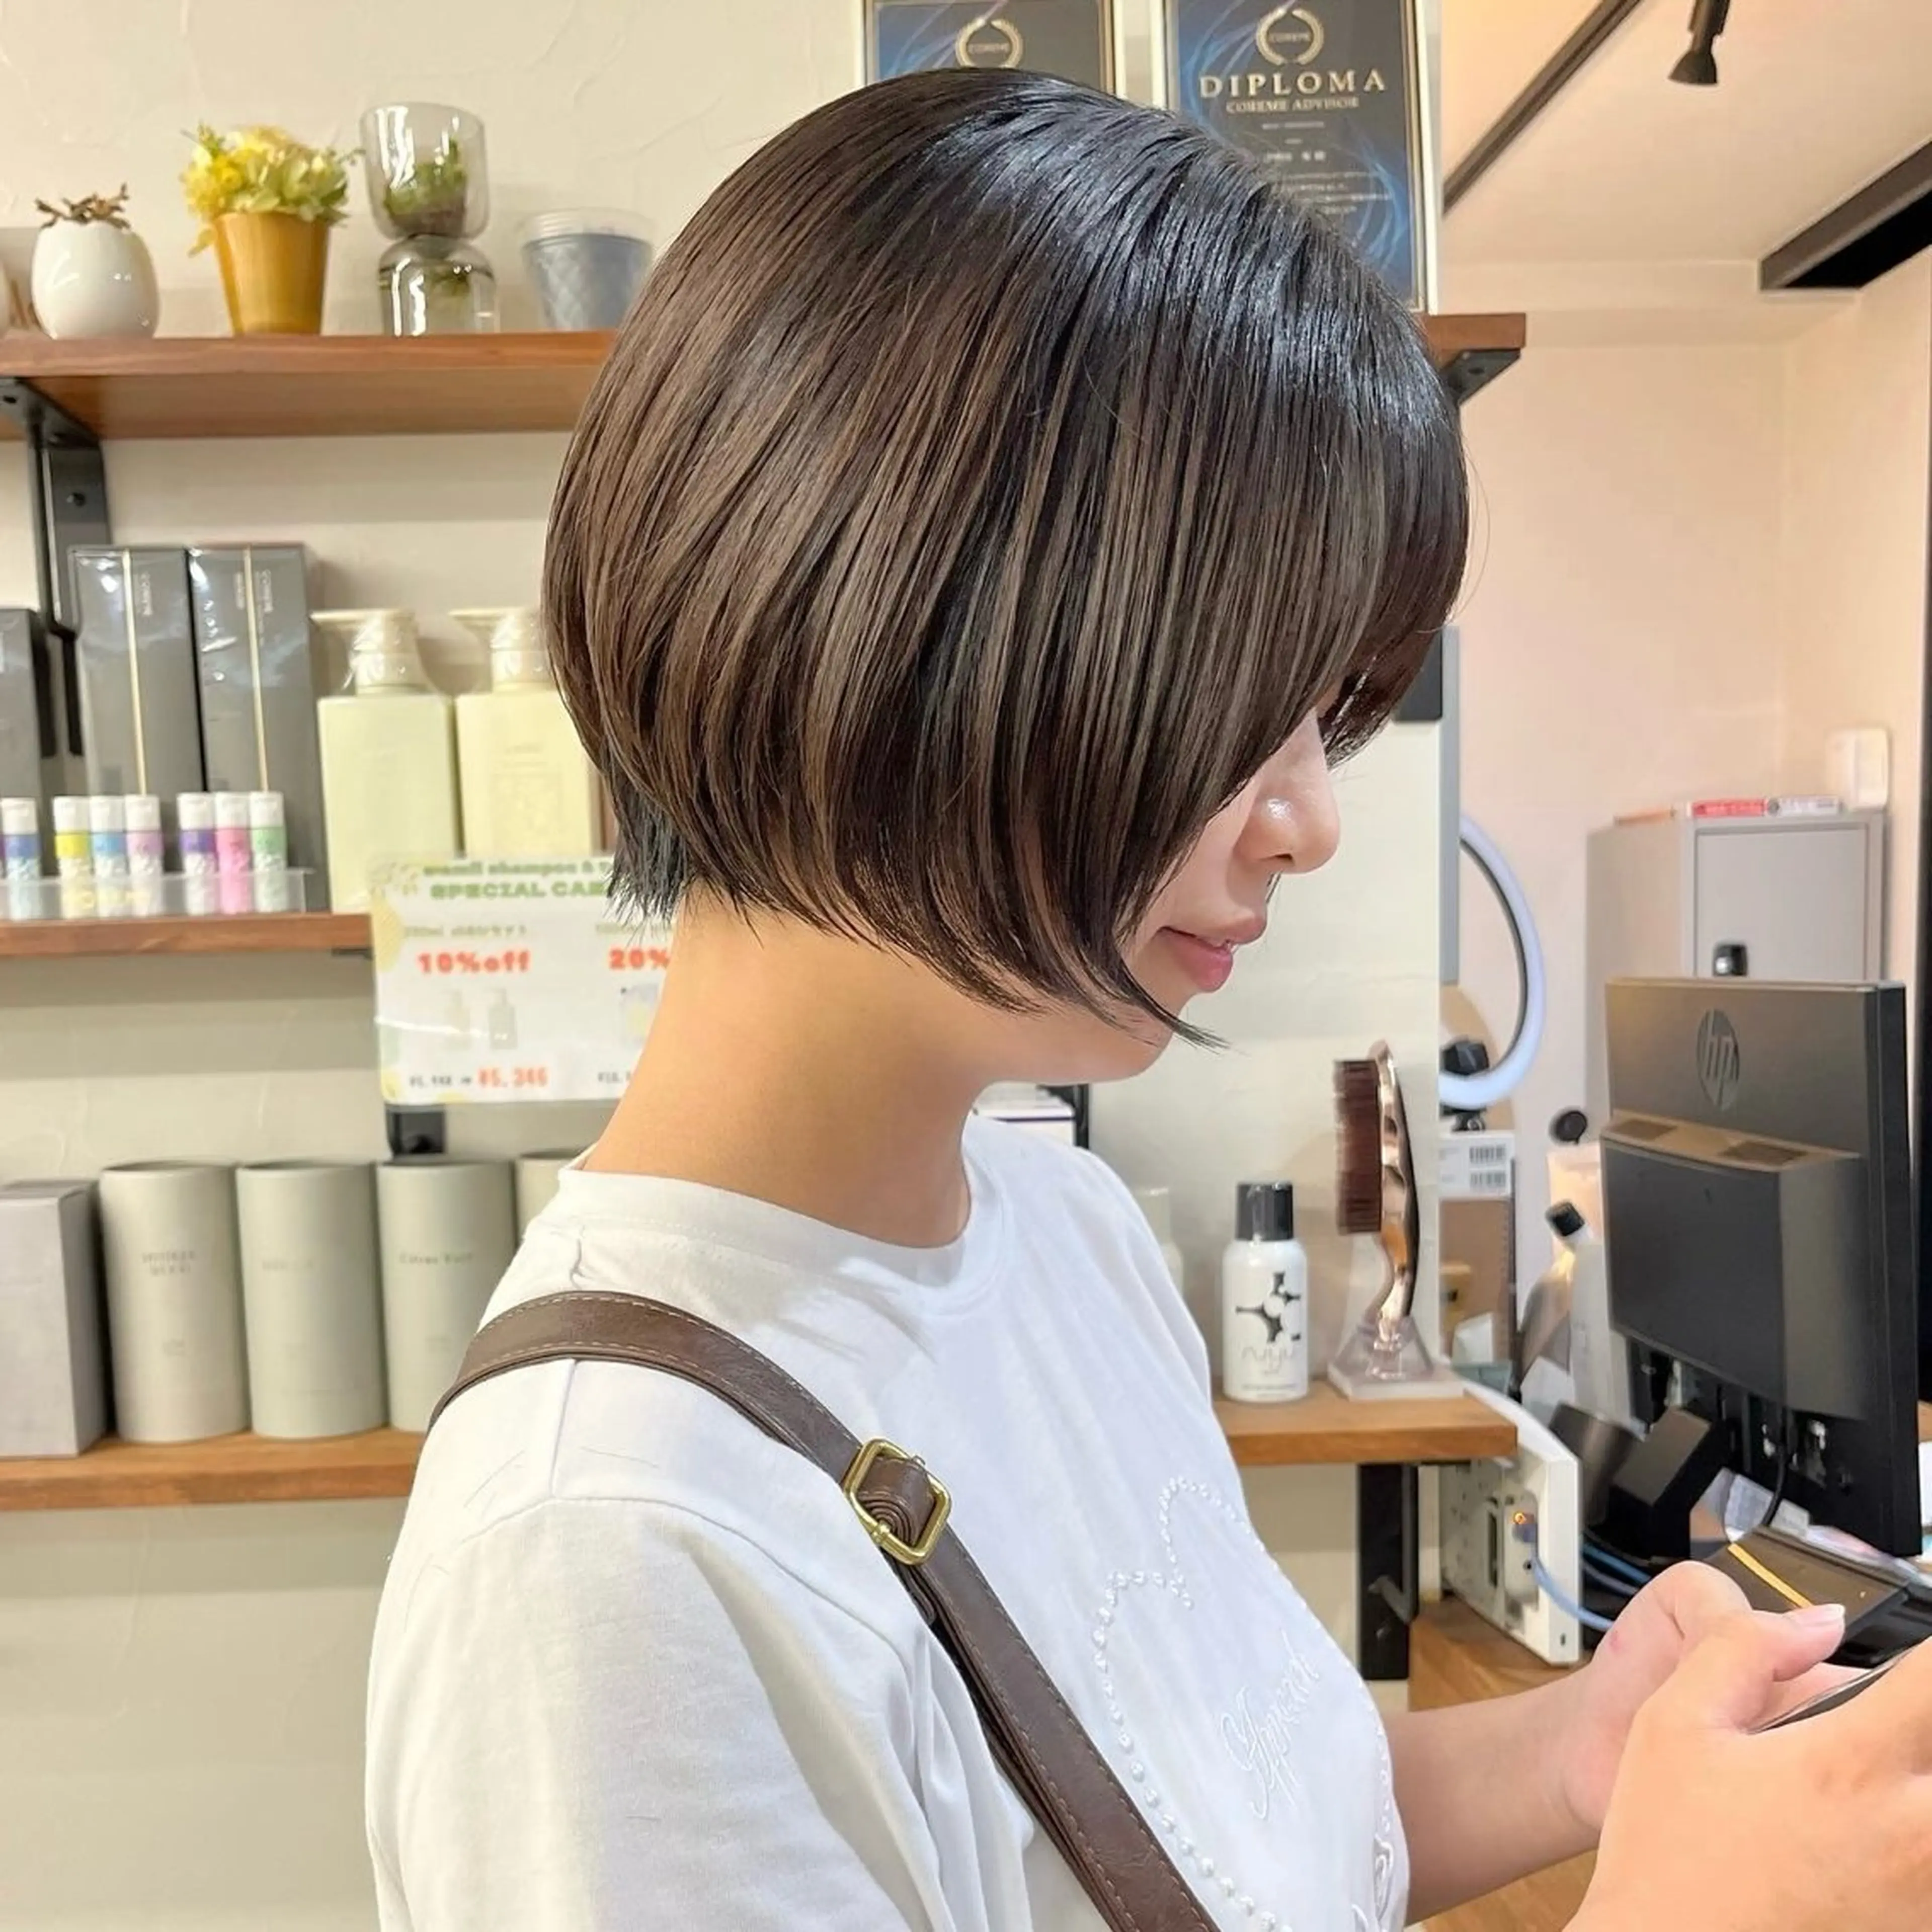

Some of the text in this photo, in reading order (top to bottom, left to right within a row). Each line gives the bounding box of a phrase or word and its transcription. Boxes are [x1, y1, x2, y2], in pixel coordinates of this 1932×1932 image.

[1198, 69, 1388, 99] DIPLOMA
[430, 881, 546, 899] SPECIAL
[417, 949, 530, 974] 10%off
